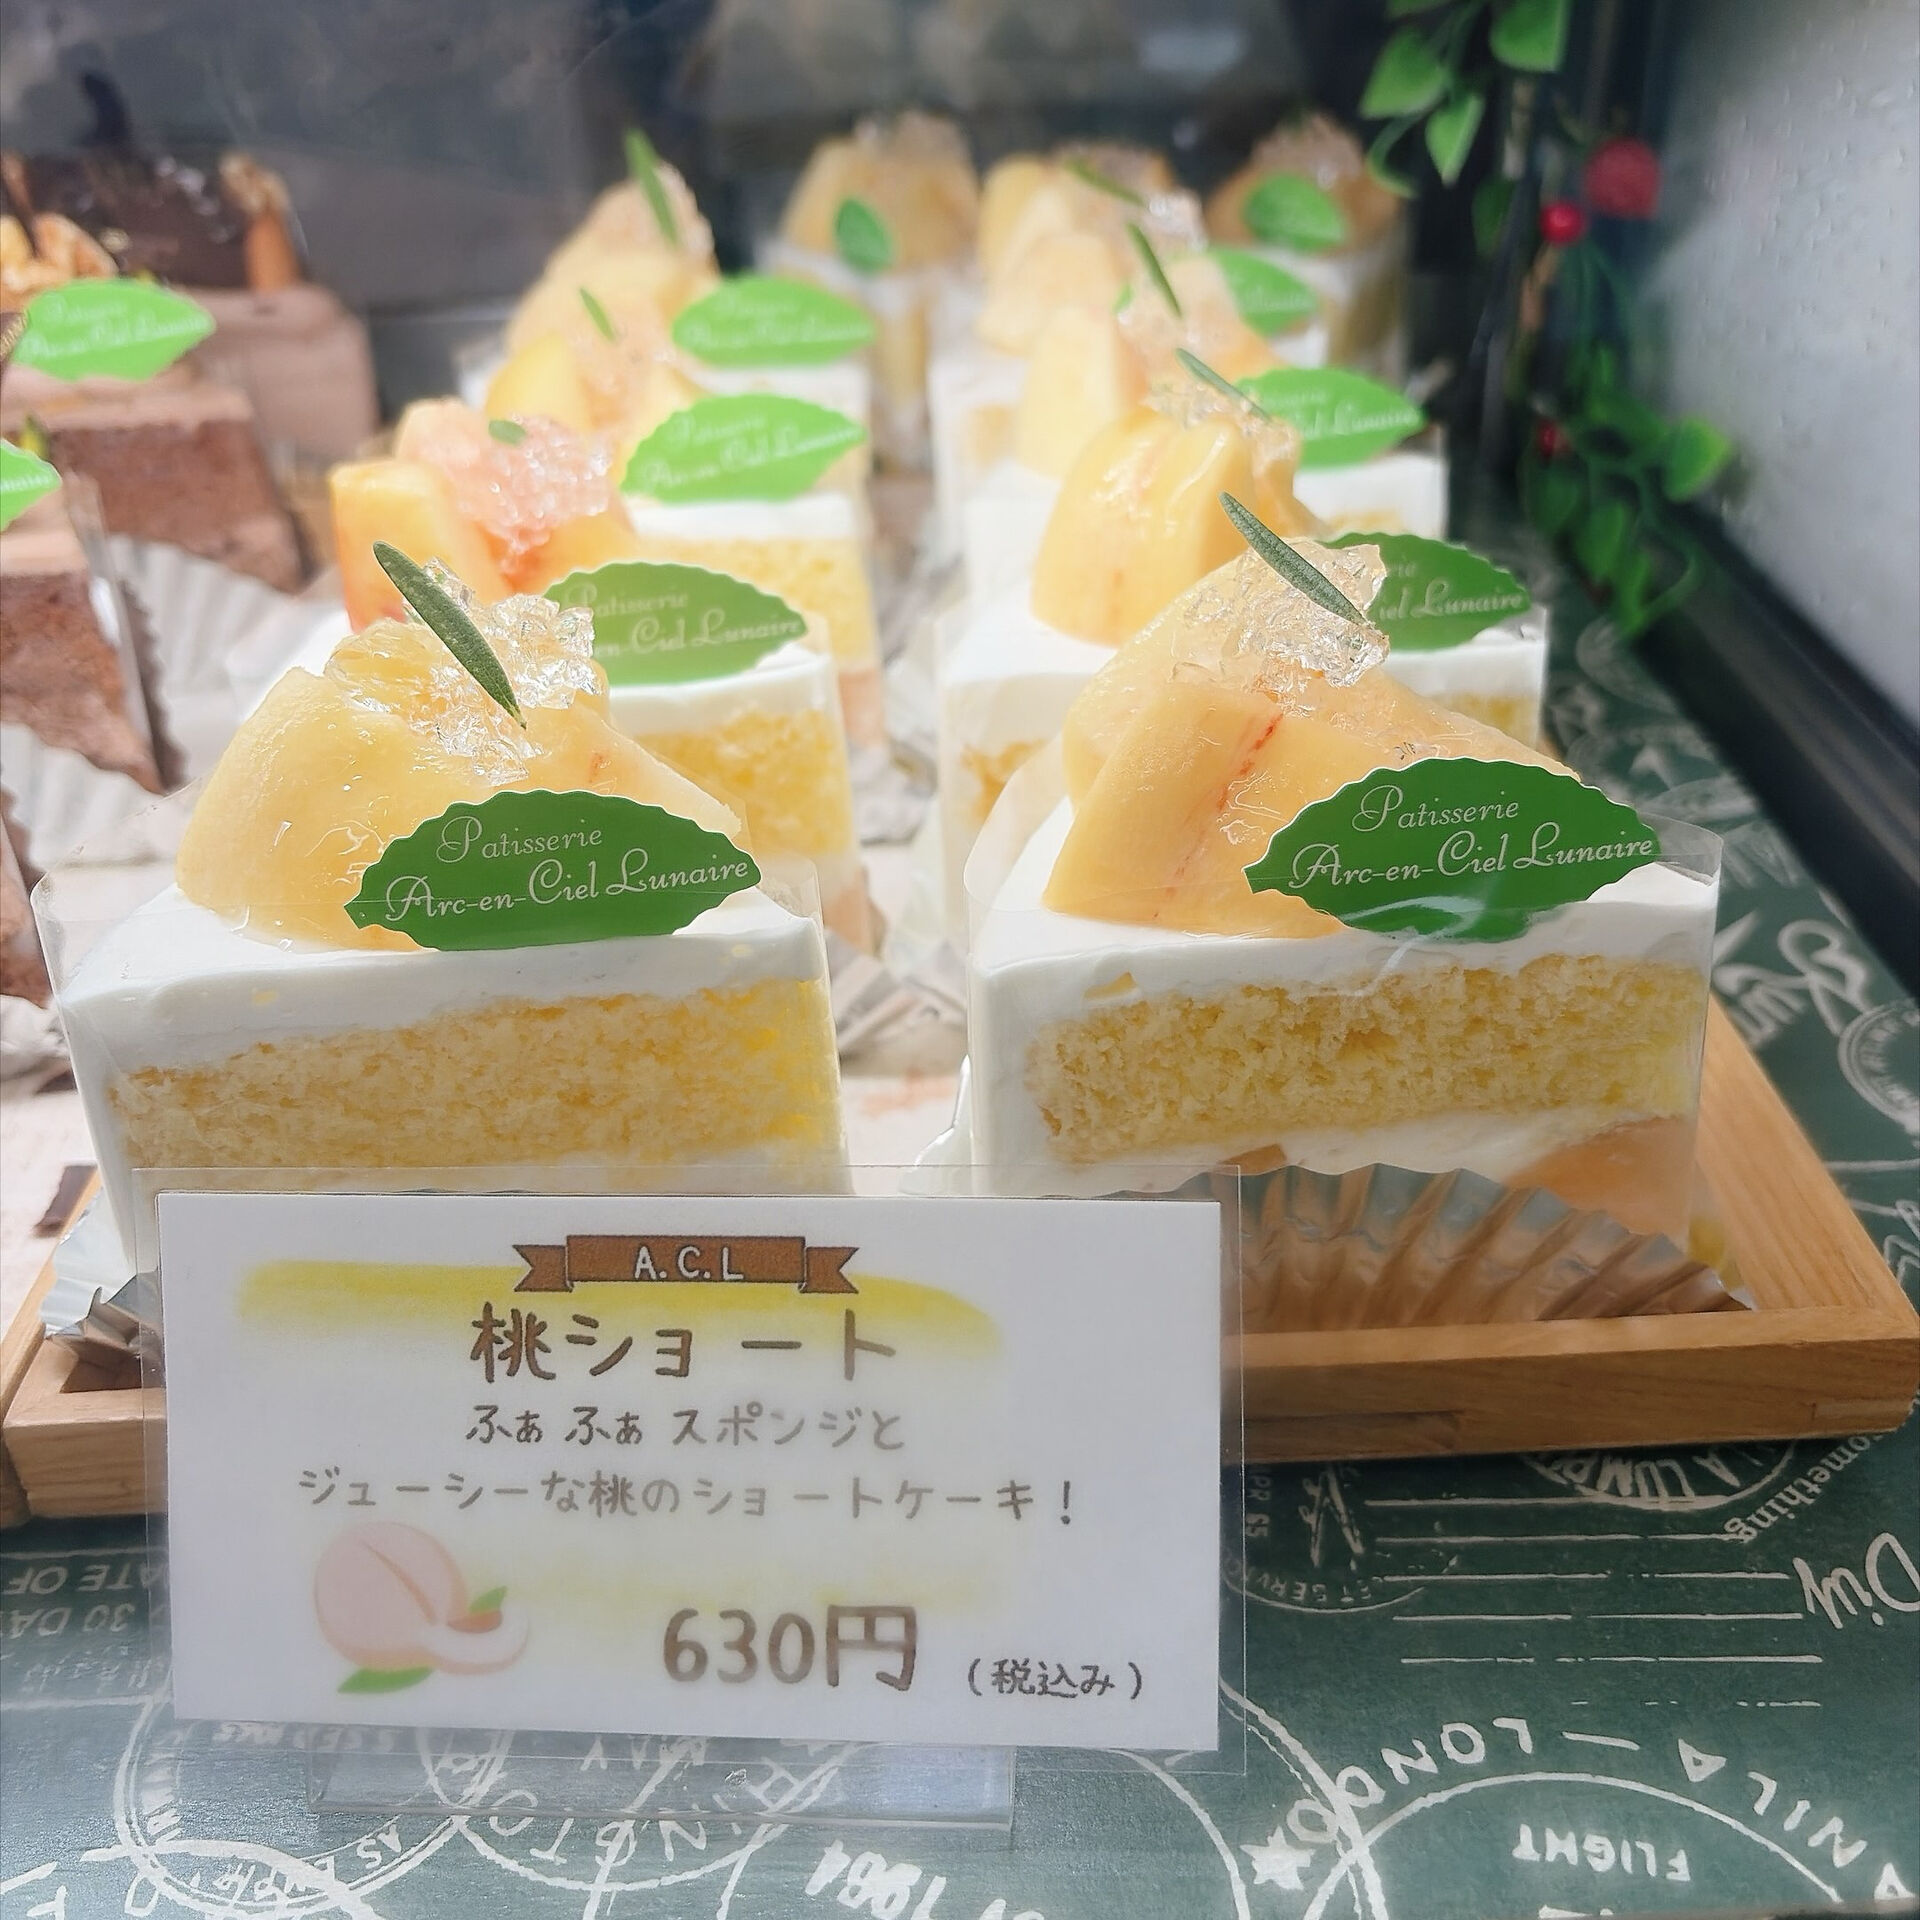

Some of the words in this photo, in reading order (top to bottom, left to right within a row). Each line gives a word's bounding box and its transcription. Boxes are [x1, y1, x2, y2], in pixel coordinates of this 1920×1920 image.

[435, 815, 603, 864] Patisserie
[1351, 784, 1520, 833] Patisserie
[385, 858, 599, 922] Arc-en-Ciel
[605, 847, 749, 896] Lunaire
[1288, 830, 1507, 889] Arc-en-Ciel
[1514, 821, 1653, 869] Lunaire
[470, 1301, 896, 1383] 桃ショート
[1723, 1434, 1884, 1544] omething
[0, 1606, 73, 1640] DA
[662, 1603, 918, 1692] 630円
[1511, 1823, 1693, 1883] FLIGHT
